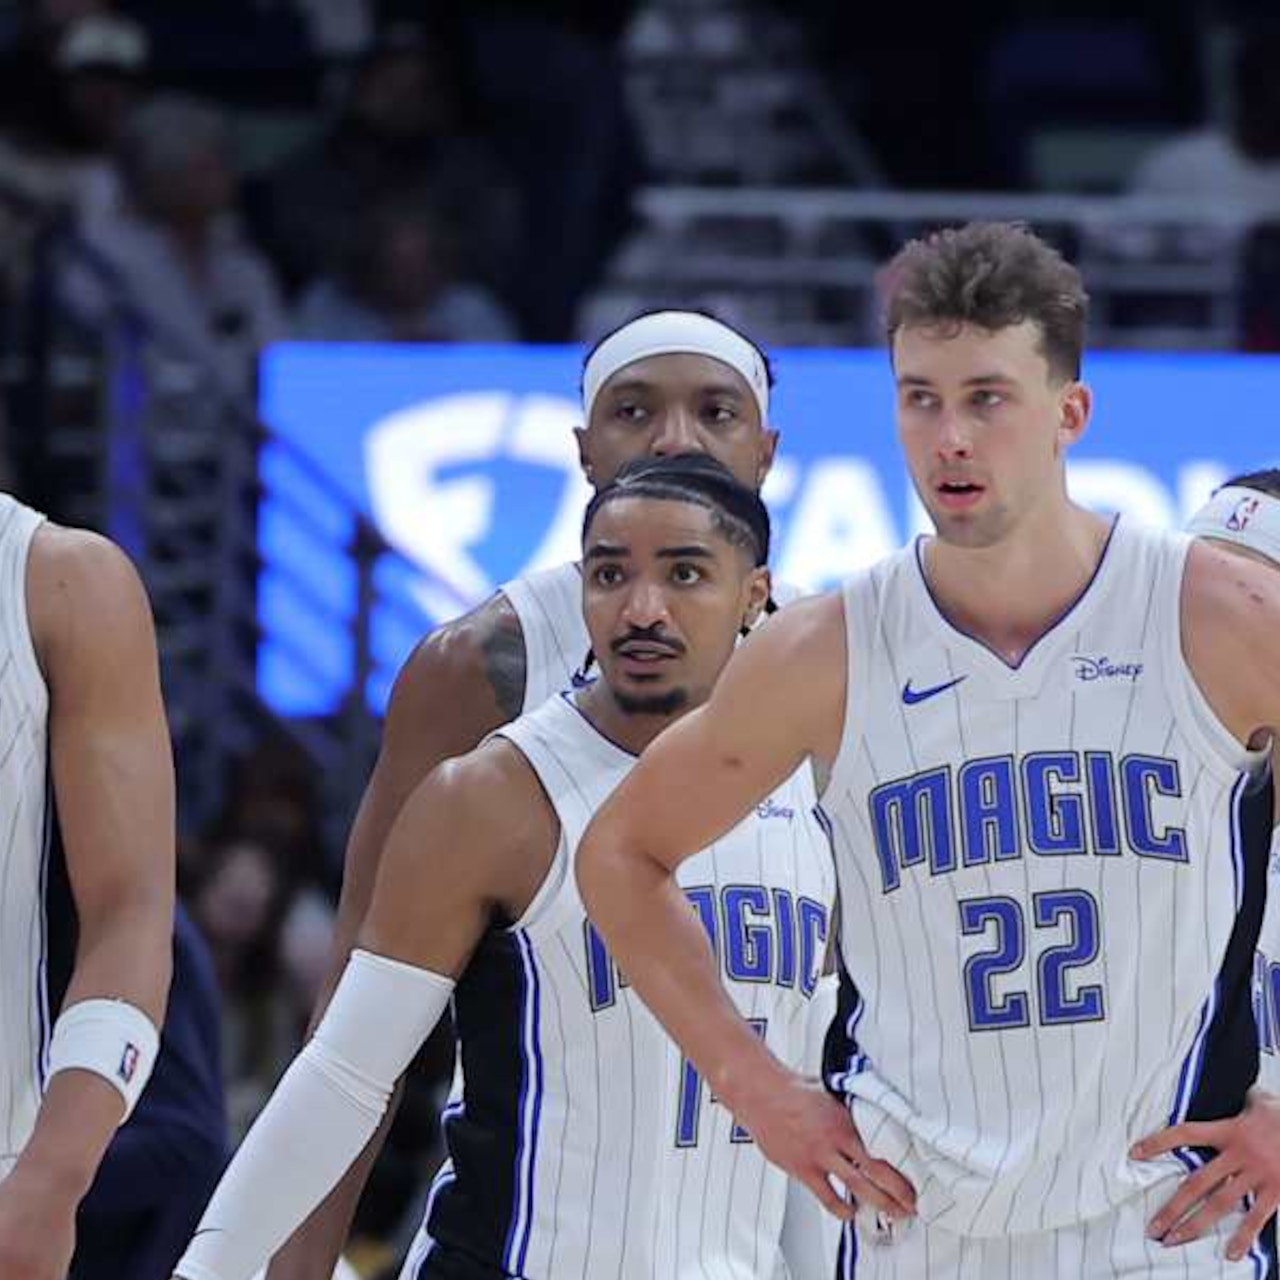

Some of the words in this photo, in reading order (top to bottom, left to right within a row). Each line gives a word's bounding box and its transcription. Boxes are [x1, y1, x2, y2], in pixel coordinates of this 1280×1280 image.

[1070, 656, 1144, 683] Disney
[868, 751, 1189, 894] MAGIC
[958, 888, 1105, 1032] 22
